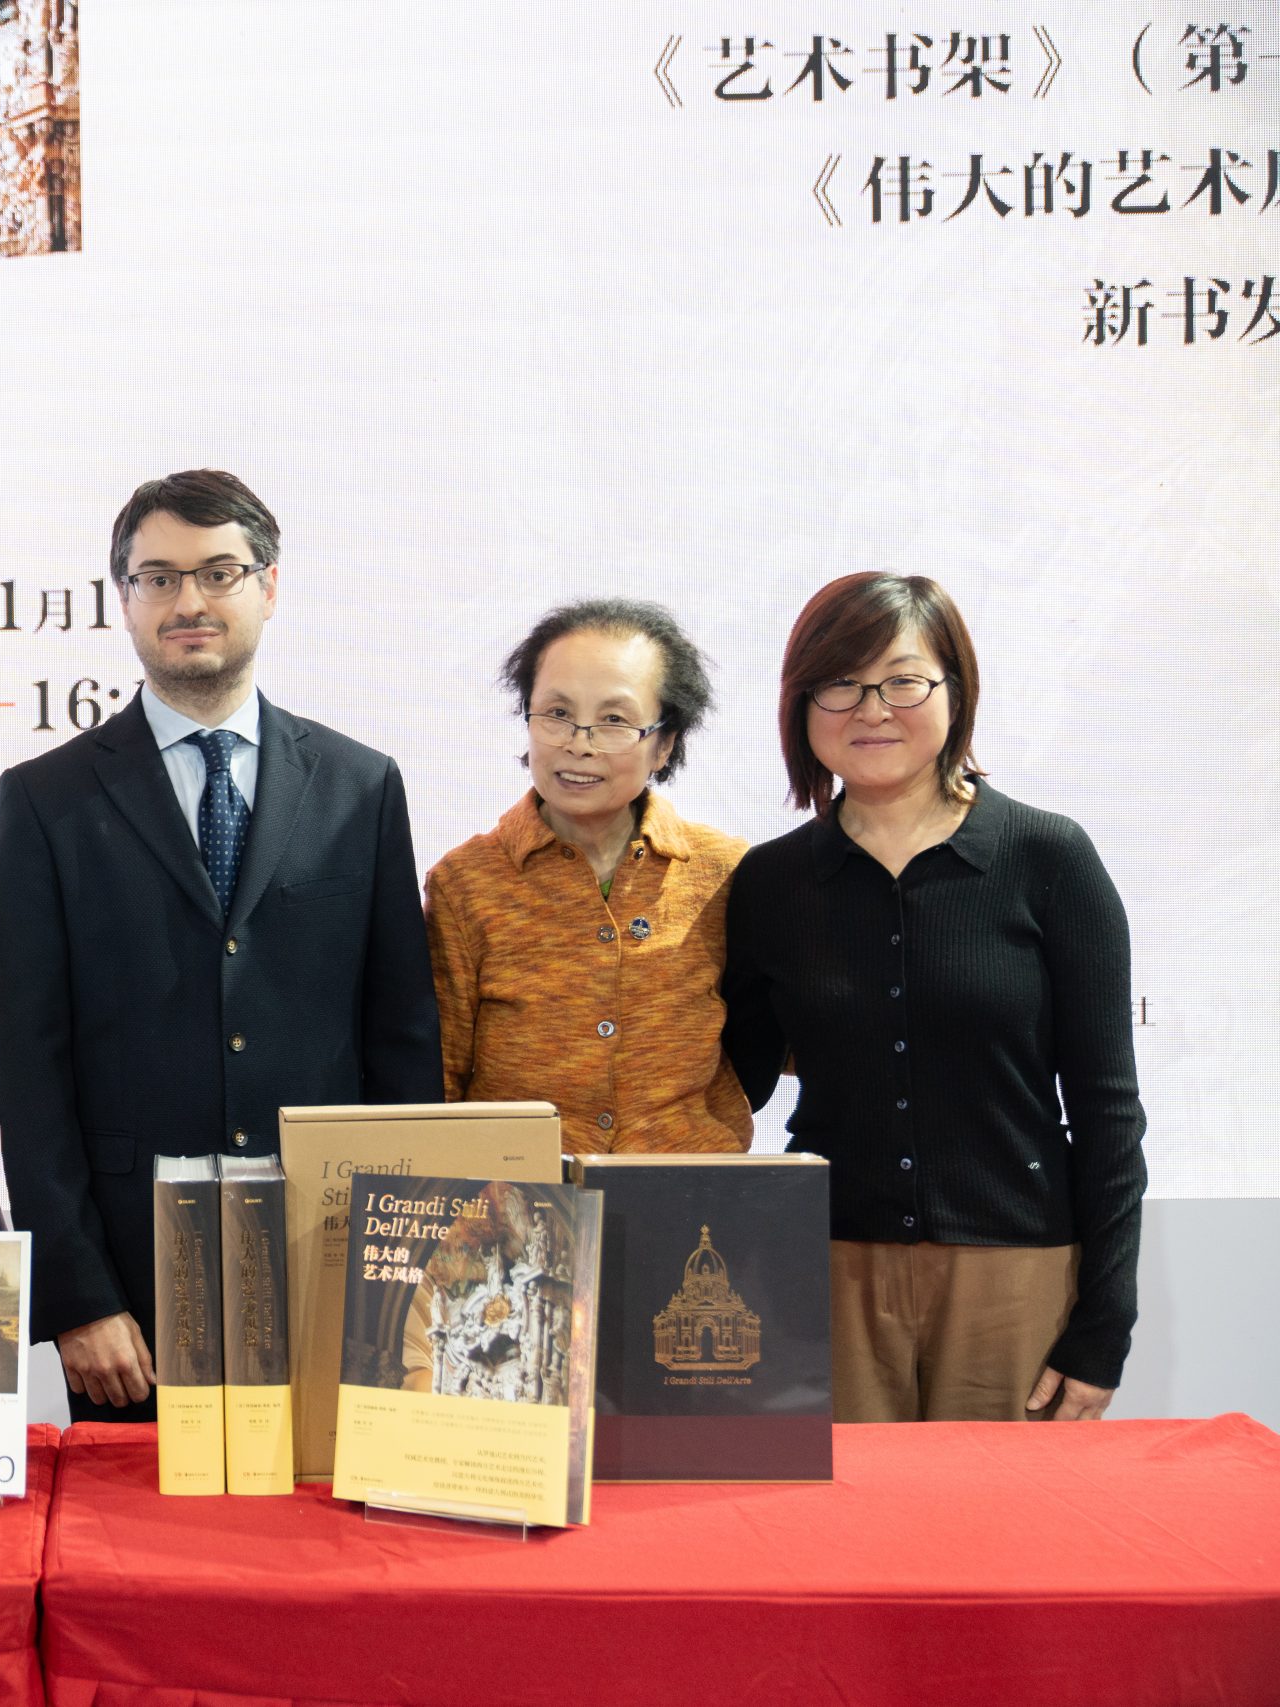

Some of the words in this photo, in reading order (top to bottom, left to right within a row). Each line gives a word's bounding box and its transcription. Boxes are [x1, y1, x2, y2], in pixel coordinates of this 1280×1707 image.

[321, 1161, 331, 1179] I
[322, 1187, 352, 1206] Sti
[365, 1193, 376, 1211] I
[379, 1194, 447, 1216] Grandi
[450, 1198, 490, 1219] Stili
[364, 1217, 449, 1240] Dell'Arte
[363, 1244, 410, 1264] 伟大的
[363, 1264, 423, 1284] 艺术风格
